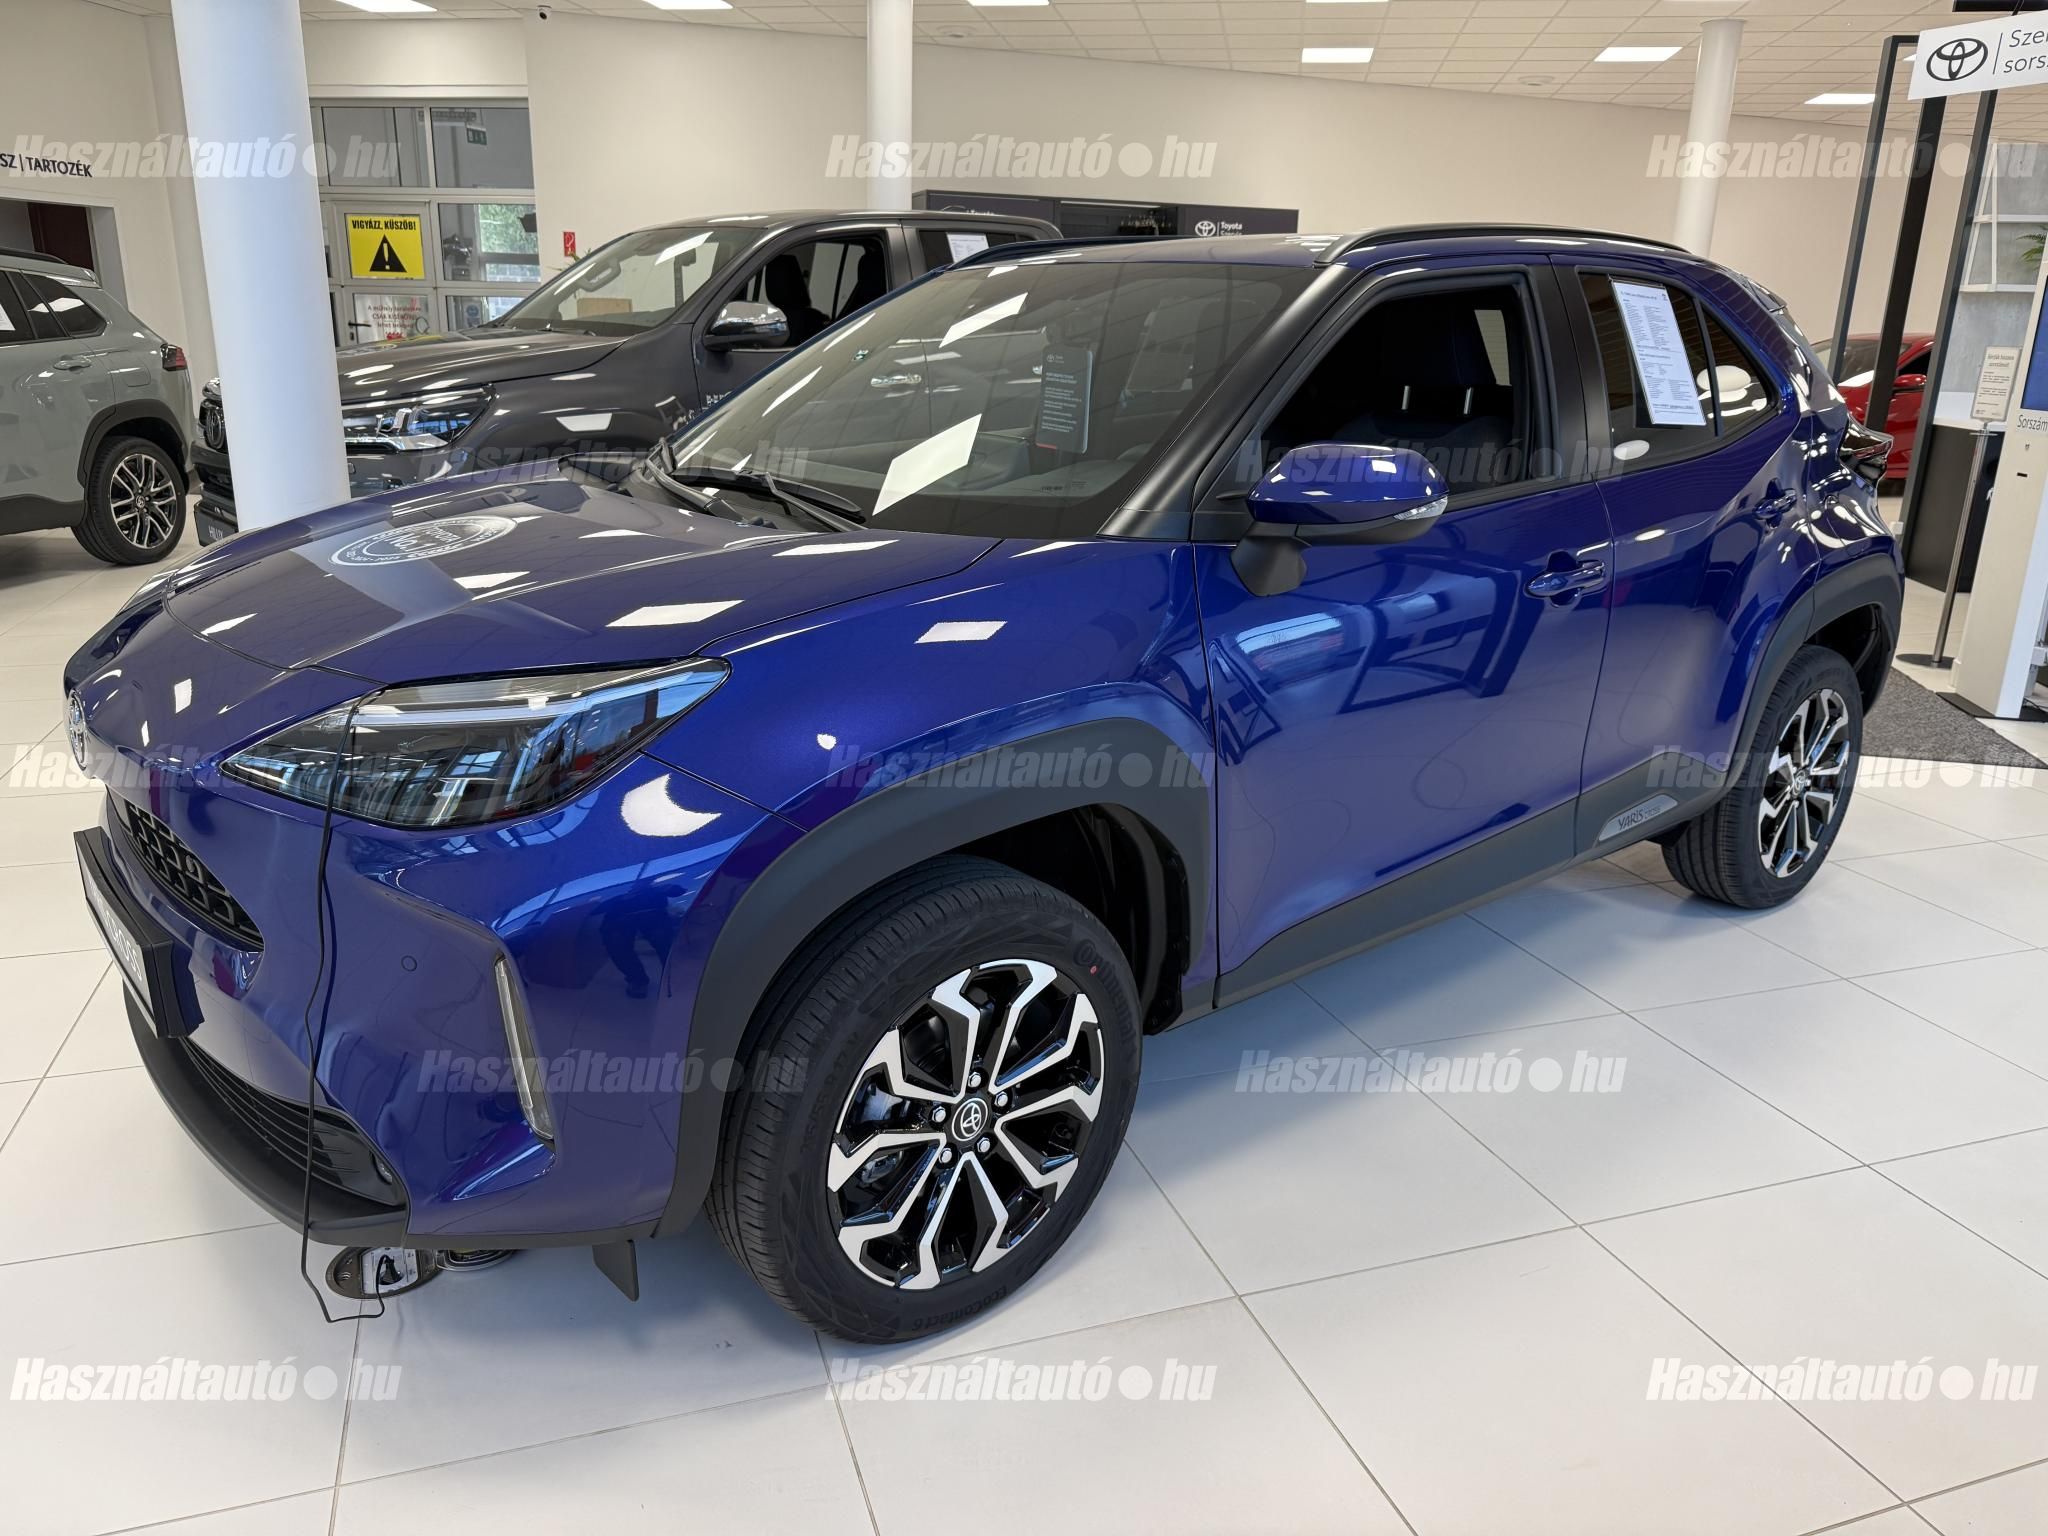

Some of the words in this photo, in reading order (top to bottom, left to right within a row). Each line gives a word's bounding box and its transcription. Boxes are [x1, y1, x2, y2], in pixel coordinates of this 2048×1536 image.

[25, 156, 93, 178] TARTOZÉK
[384, 219, 417, 231] KÜSZÖB!
[1220, 221, 1243, 231] Toyota
[1617, 807, 1645, 830] YARIS
